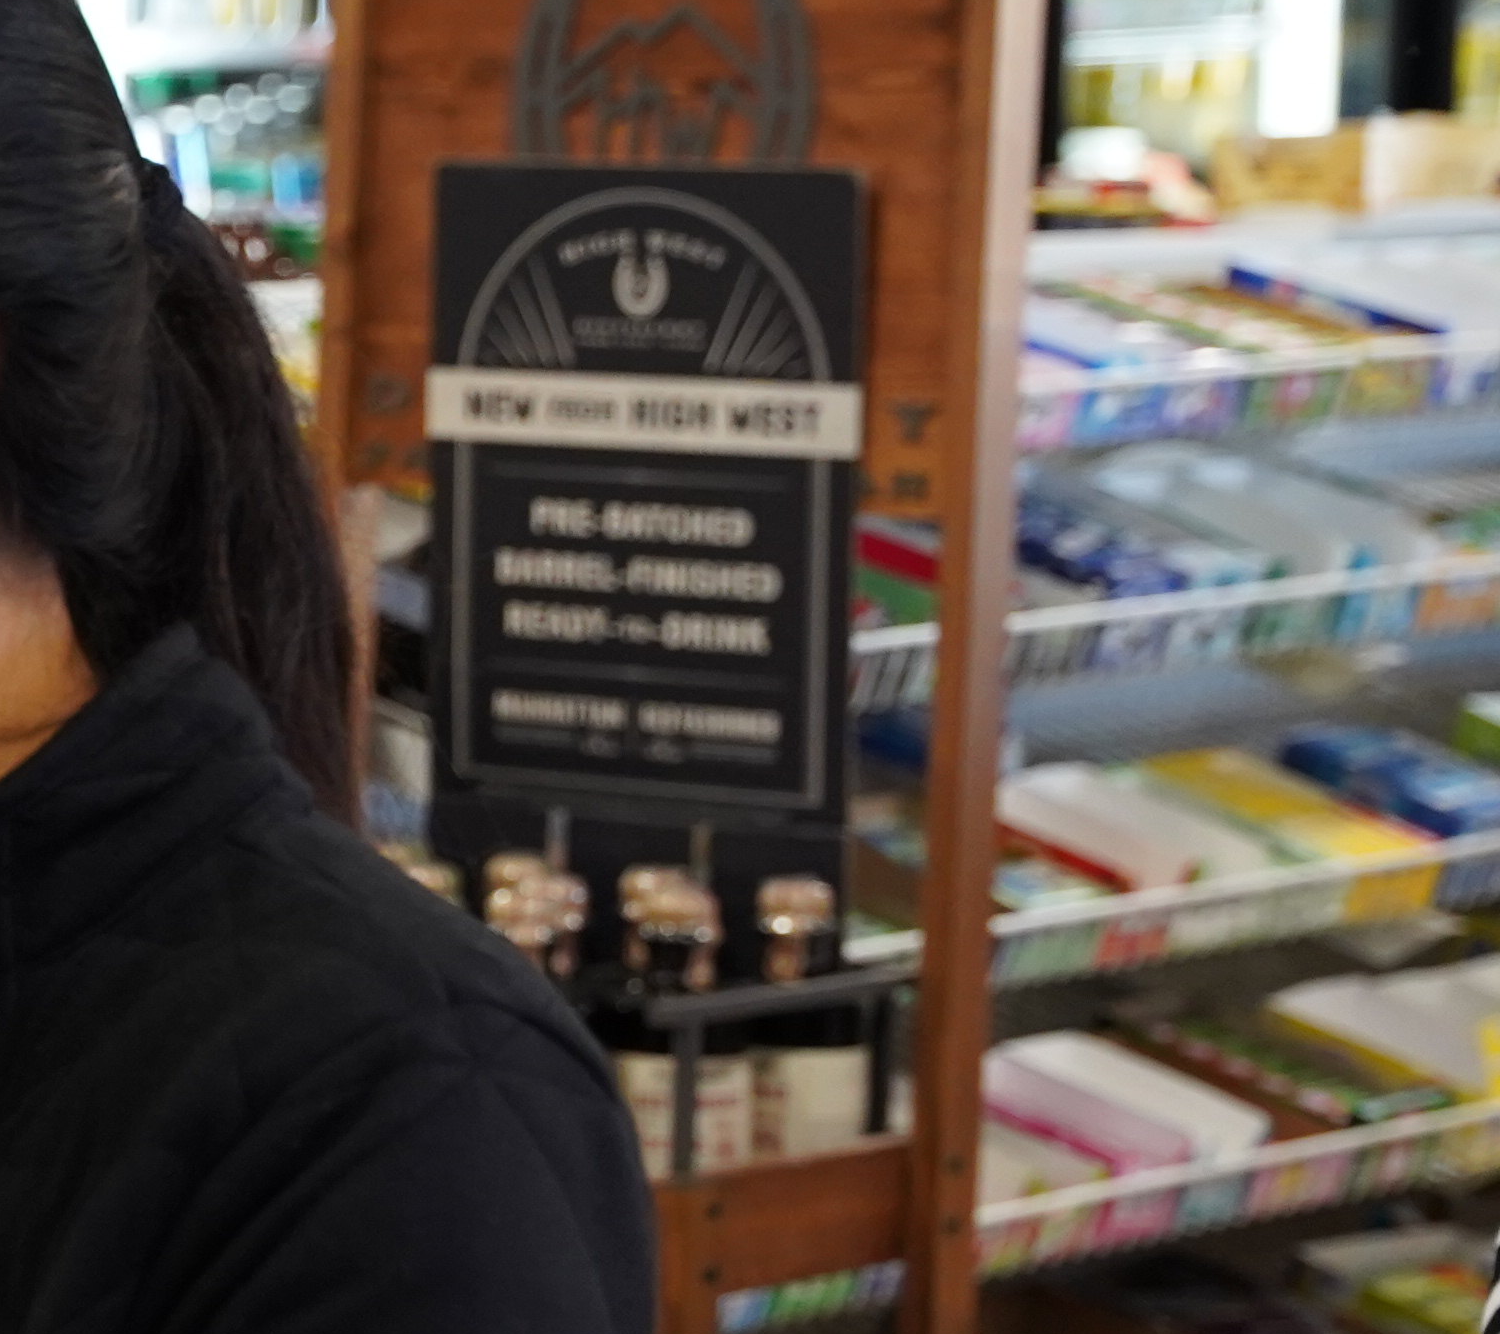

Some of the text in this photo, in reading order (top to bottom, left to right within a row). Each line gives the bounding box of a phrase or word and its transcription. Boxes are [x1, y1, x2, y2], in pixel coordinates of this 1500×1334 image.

[462, 386, 535, 424] NEW
[627, 395, 717, 430] HIGH
[725, 399, 821, 436] WEST
[529, 495, 757, 548] PRE-BATCHED
